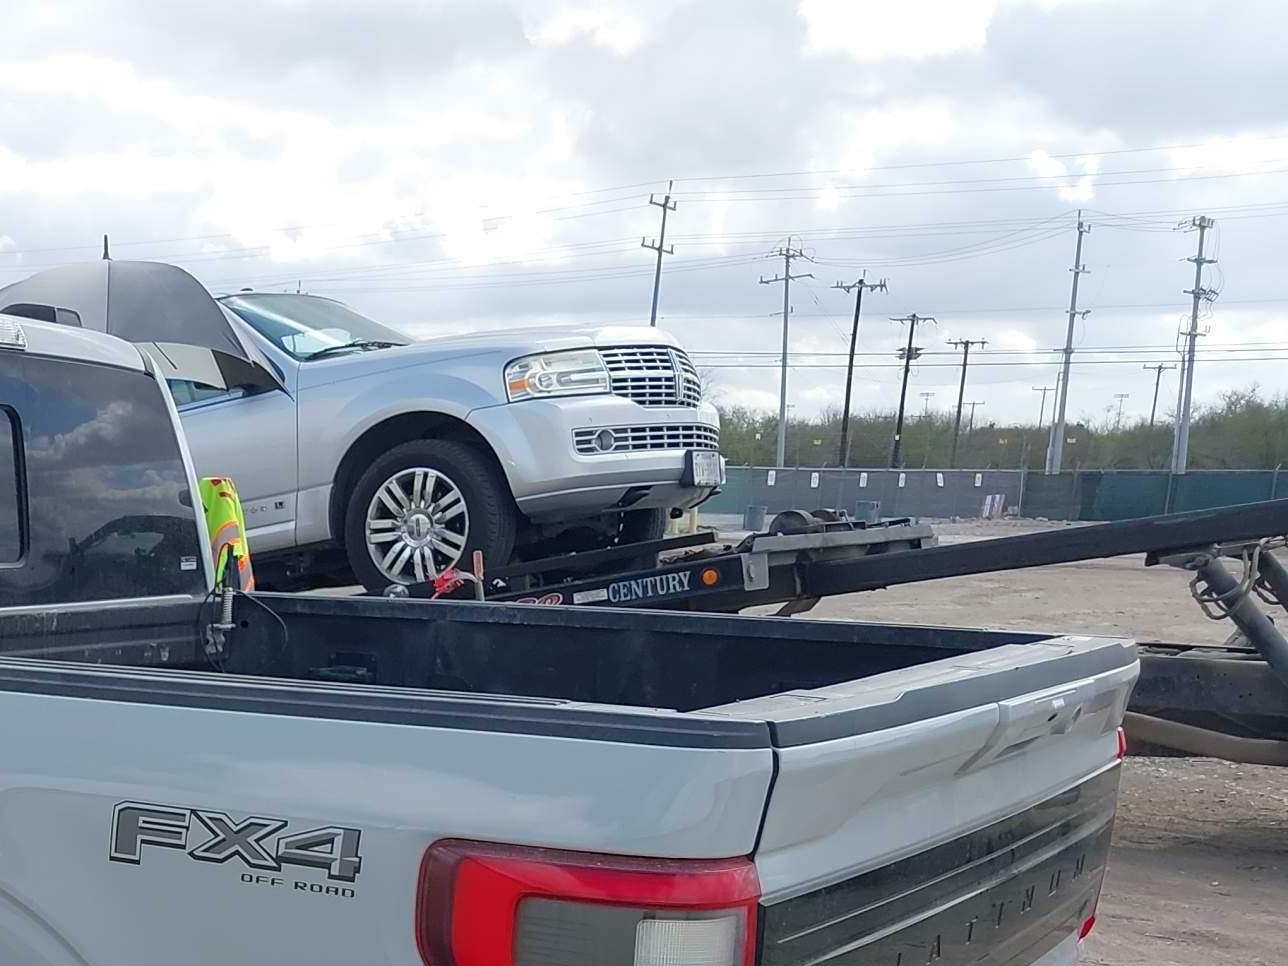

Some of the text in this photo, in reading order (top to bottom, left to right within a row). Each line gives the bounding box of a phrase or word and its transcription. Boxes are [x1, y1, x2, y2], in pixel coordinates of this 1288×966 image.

[608, 571, 691, 602] CENTURY
[109, 800, 362, 883] FX4
[240, 873, 356, 898] OFF ROAD
